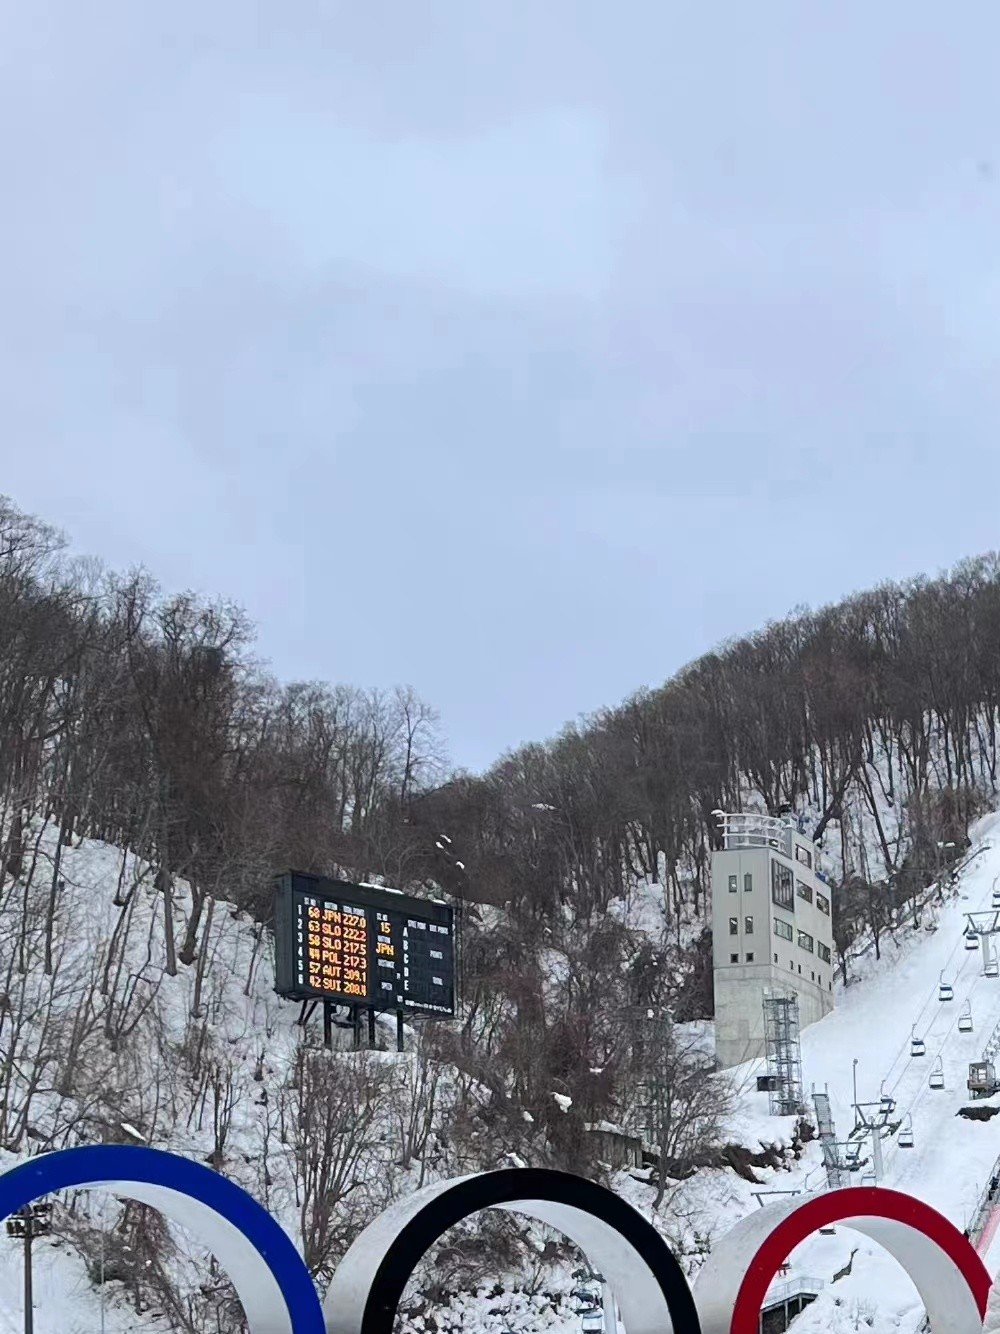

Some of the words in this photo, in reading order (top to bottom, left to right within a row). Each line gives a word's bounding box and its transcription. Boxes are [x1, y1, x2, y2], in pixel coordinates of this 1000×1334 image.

[322, 909, 341, 924] JPN
[322, 923, 341, 936] SLO
[322, 936, 341, 950] SLO
[375, 942, 394, 956] JPN
[322, 950, 342, 964] POL
[322, 965, 342, 977] AUT
